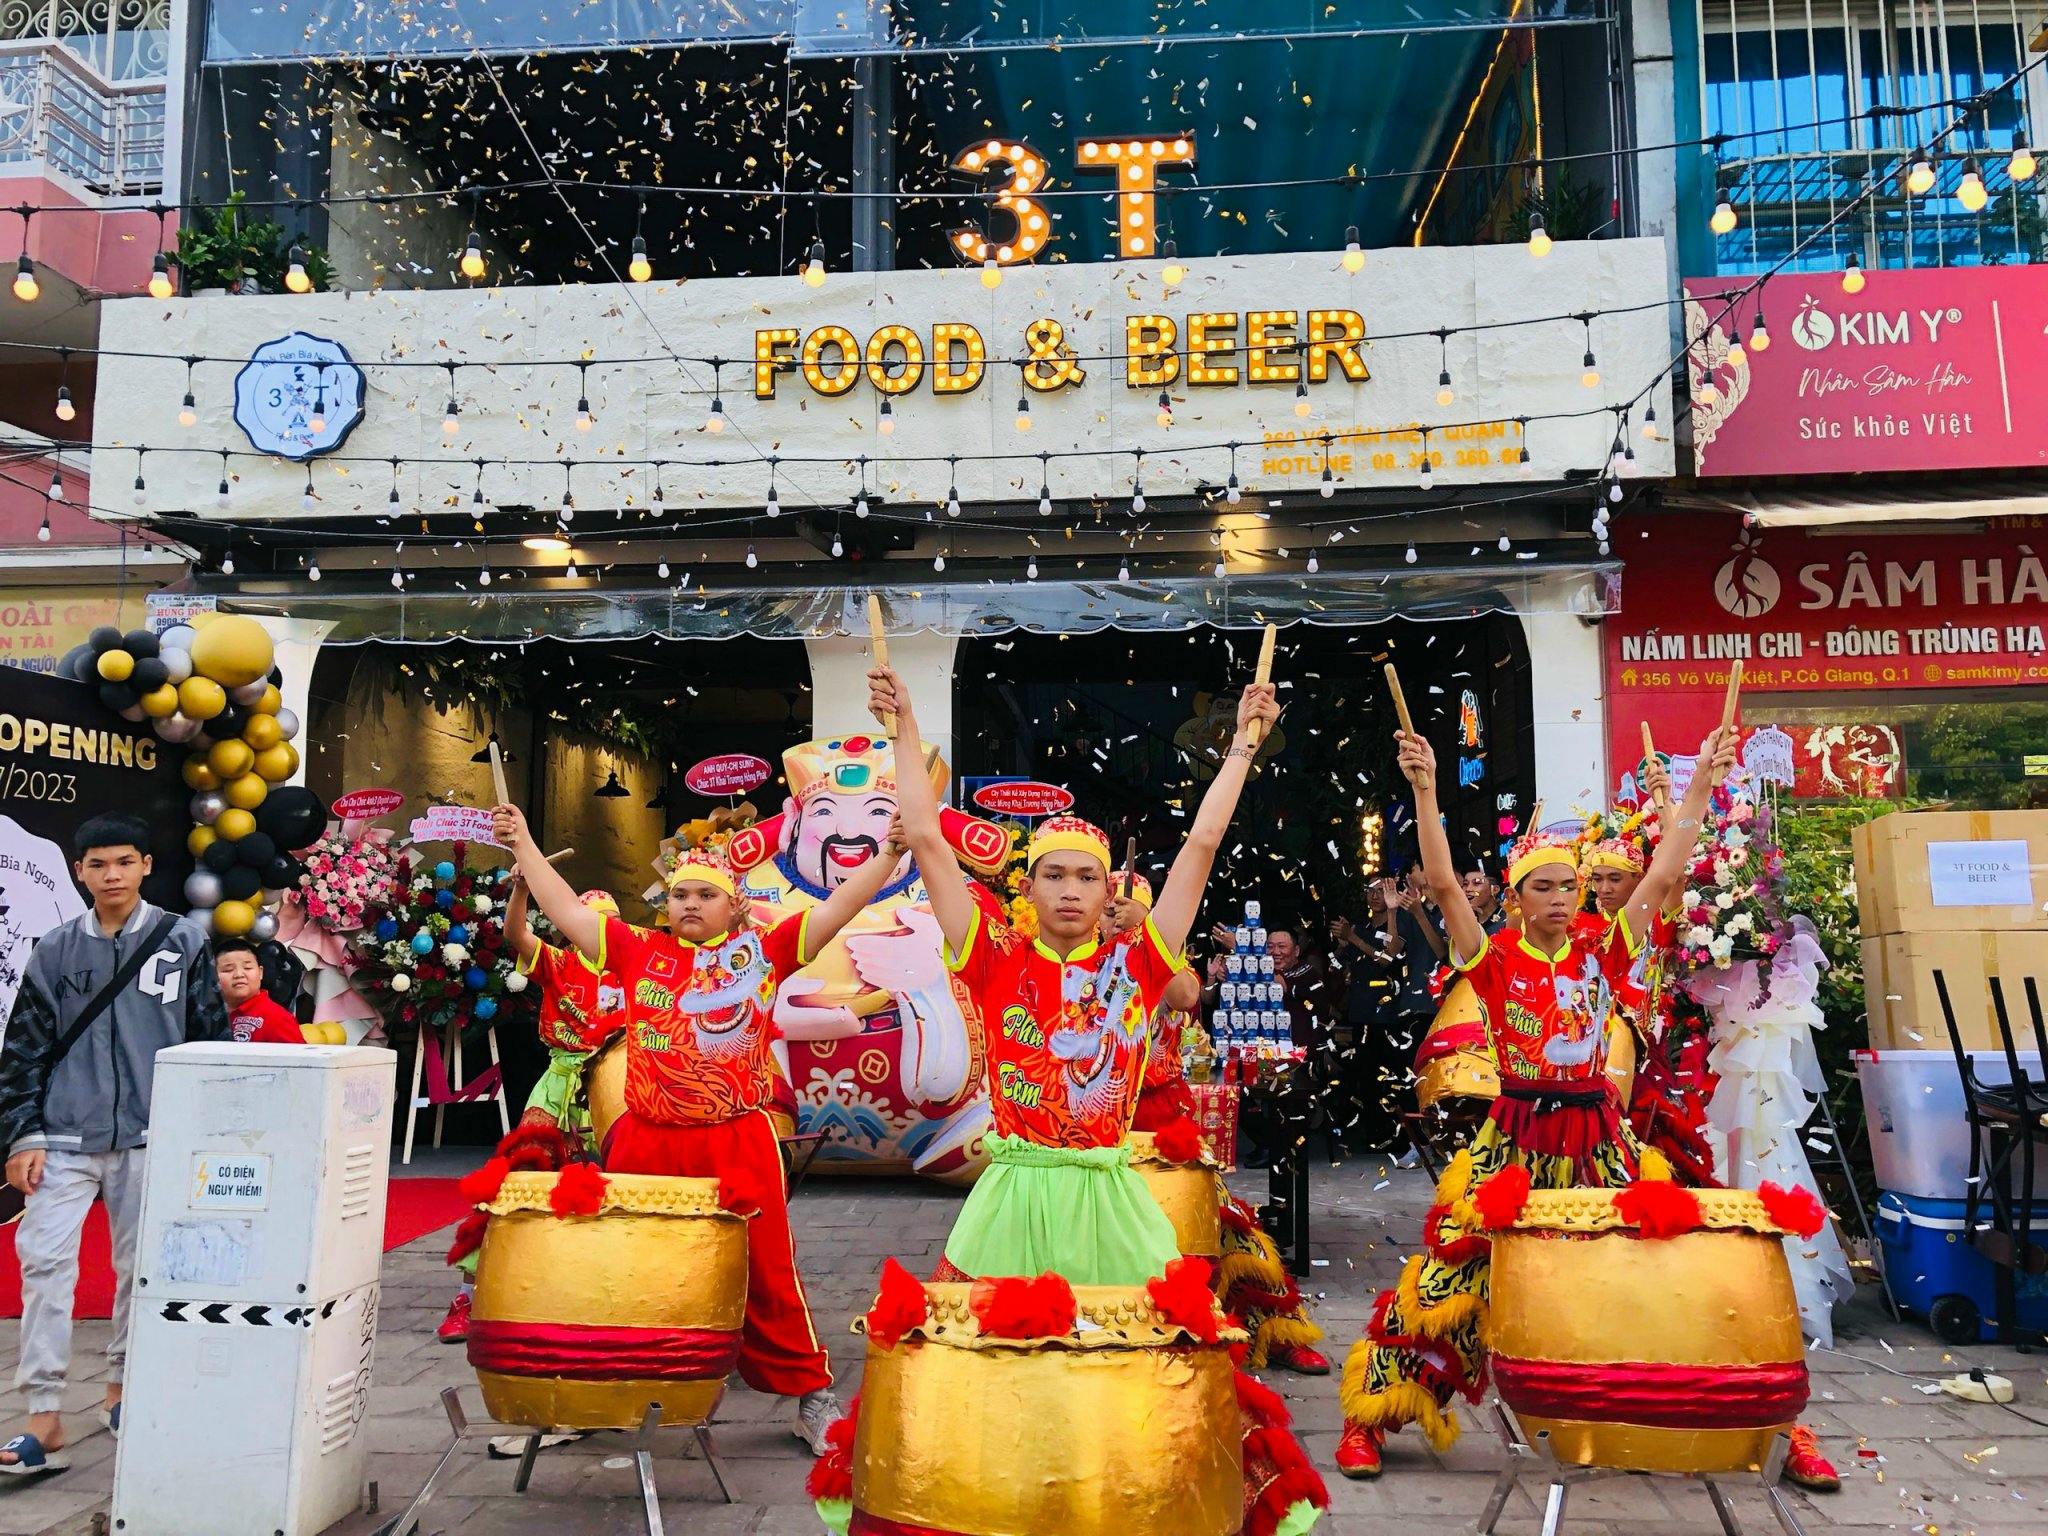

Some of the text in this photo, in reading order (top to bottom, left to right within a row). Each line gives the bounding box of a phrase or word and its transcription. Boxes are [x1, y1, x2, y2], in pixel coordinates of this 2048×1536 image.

[1840, 310, 1910, 346] KIM
[756, 309, 1371, 400] FOOD & BEER
[1798, 361, 1972, 398] Nhân Sâm Hàn
[1800, 413, 1973, 439] Sức khỏe Việt
[1262, 454, 1353, 475] HOTLINE
[1798, 545, 2048, 610] SÂM HÀ
[1622, 627, 1686, 661] NẤM
[1693, 632, 1752, 660] LINH
[1760, 632, 1803, 658] CHI
[1826, 624, 1900, 657] ĐÔNG
[1907, 621, 1999, 656] TRÙNG
[2005, 625, 2046, 658] HẠ
[1642, 672, 1671, 686] 356
[1678, 671, 1700, 686] Võ
[1825, 668, 1879, 685] Giang,
[1882, 667, 1909, 681] Q.1
[0, 713, 157, 771] OPENING
[696, 777, 710, 789] Chúc
[716, 775, 727, 786] Khai
[703, 764, 716, 775] ANH
[739, 759, 755, 769] SUNG
[436, 816, 459, 827] Chúc
[460, 818, 472, 828] 3T
[472, 821, 494, 832] Food
[0, 853, 56, 892] Bia Ngon
[1968, 862, 1999, 871] FOOD
[2002, 862, 2011, 871] &
[1968, 874, 1997, 882] BEER
[635, 977, 675, 1010] Phúc
[636, 1019, 670, 1052] Tâm
[1505, 1000, 1543, 1038] Phúc
[998, 1060, 1042, 1109] Tâm
[218, 1163, 255, 1181] CÓ ĐIỆN
[208, 1183, 234, 1196] NGUY
